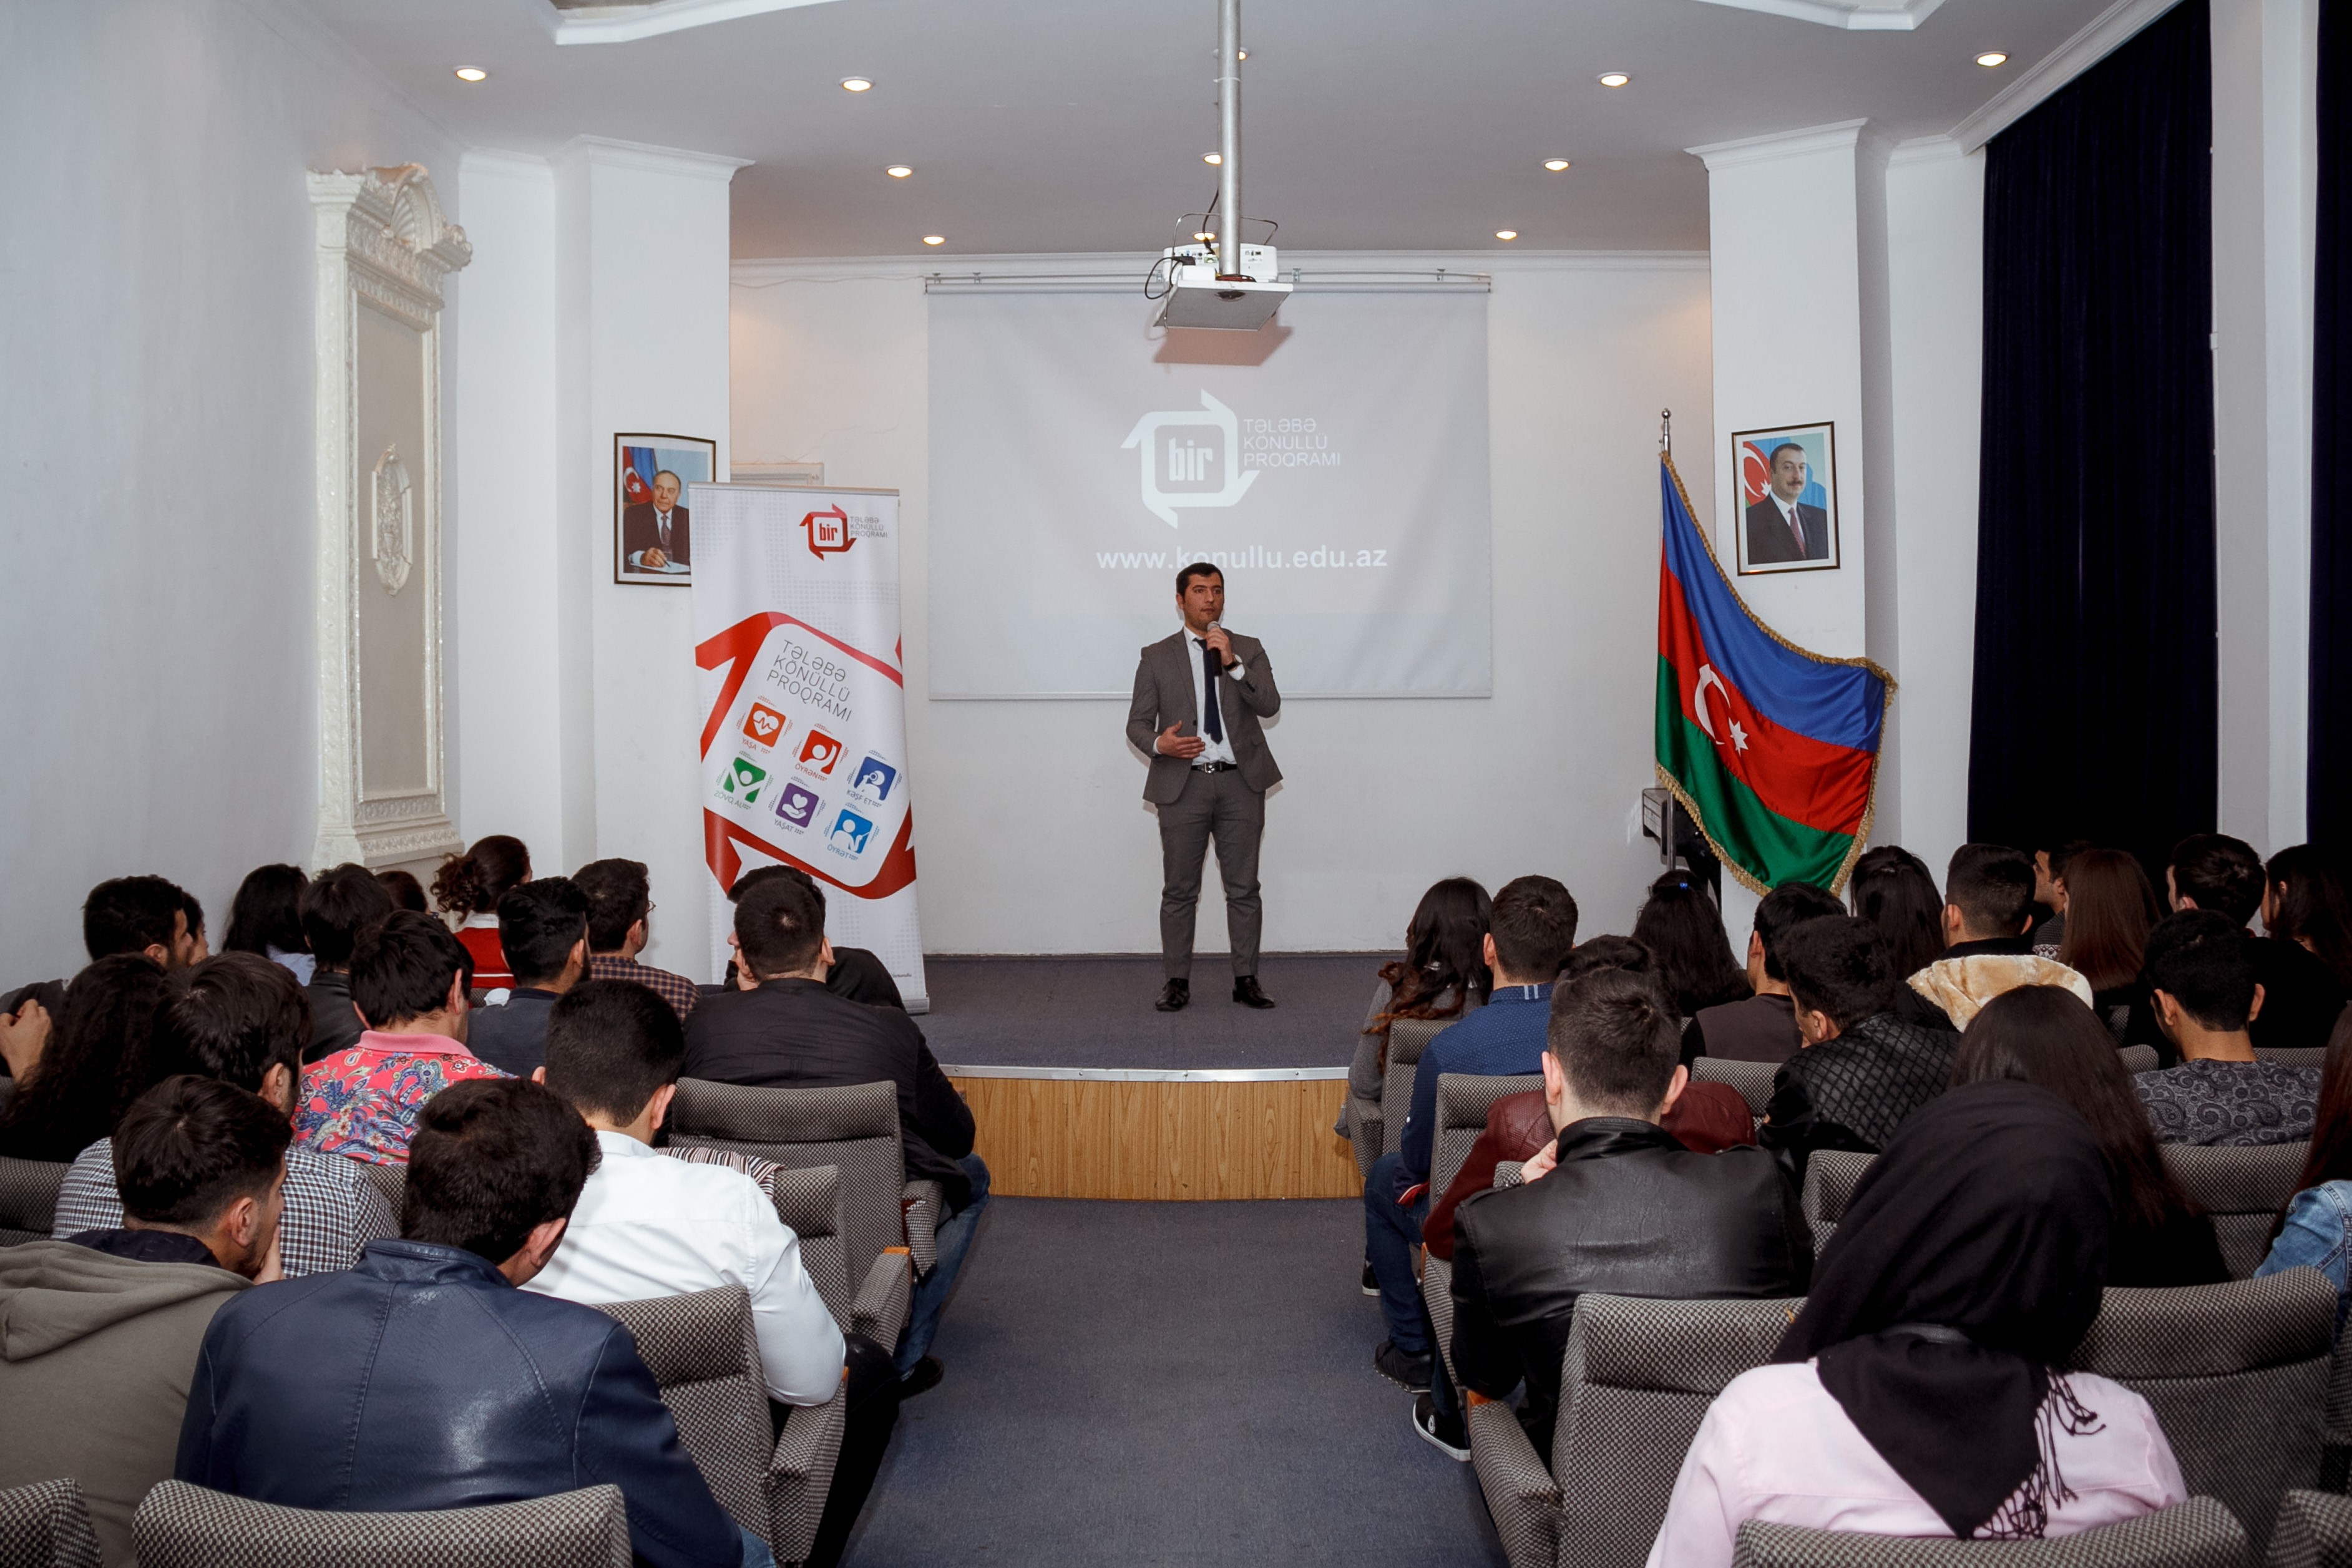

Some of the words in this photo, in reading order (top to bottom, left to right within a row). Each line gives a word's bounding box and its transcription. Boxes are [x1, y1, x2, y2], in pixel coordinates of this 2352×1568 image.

[1243, 418, 1317, 433] TƏLƏBƏ
[1169, 437, 1213, 481] bir
[1244, 452, 1340, 467] PROQRAMI
[850, 516, 879, 524] TƏLƏBƏ
[819, 522, 838, 541] bir
[850, 530, 888, 538] PROQRAMI
[1096, 545, 1388, 569] www.konullu.edu.az
[783, 640, 846, 682] TƏLƏBƏ
[773, 655, 850, 702] KÖNÜLLÜ
[766, 670, 852, 722] PROQRAMI
